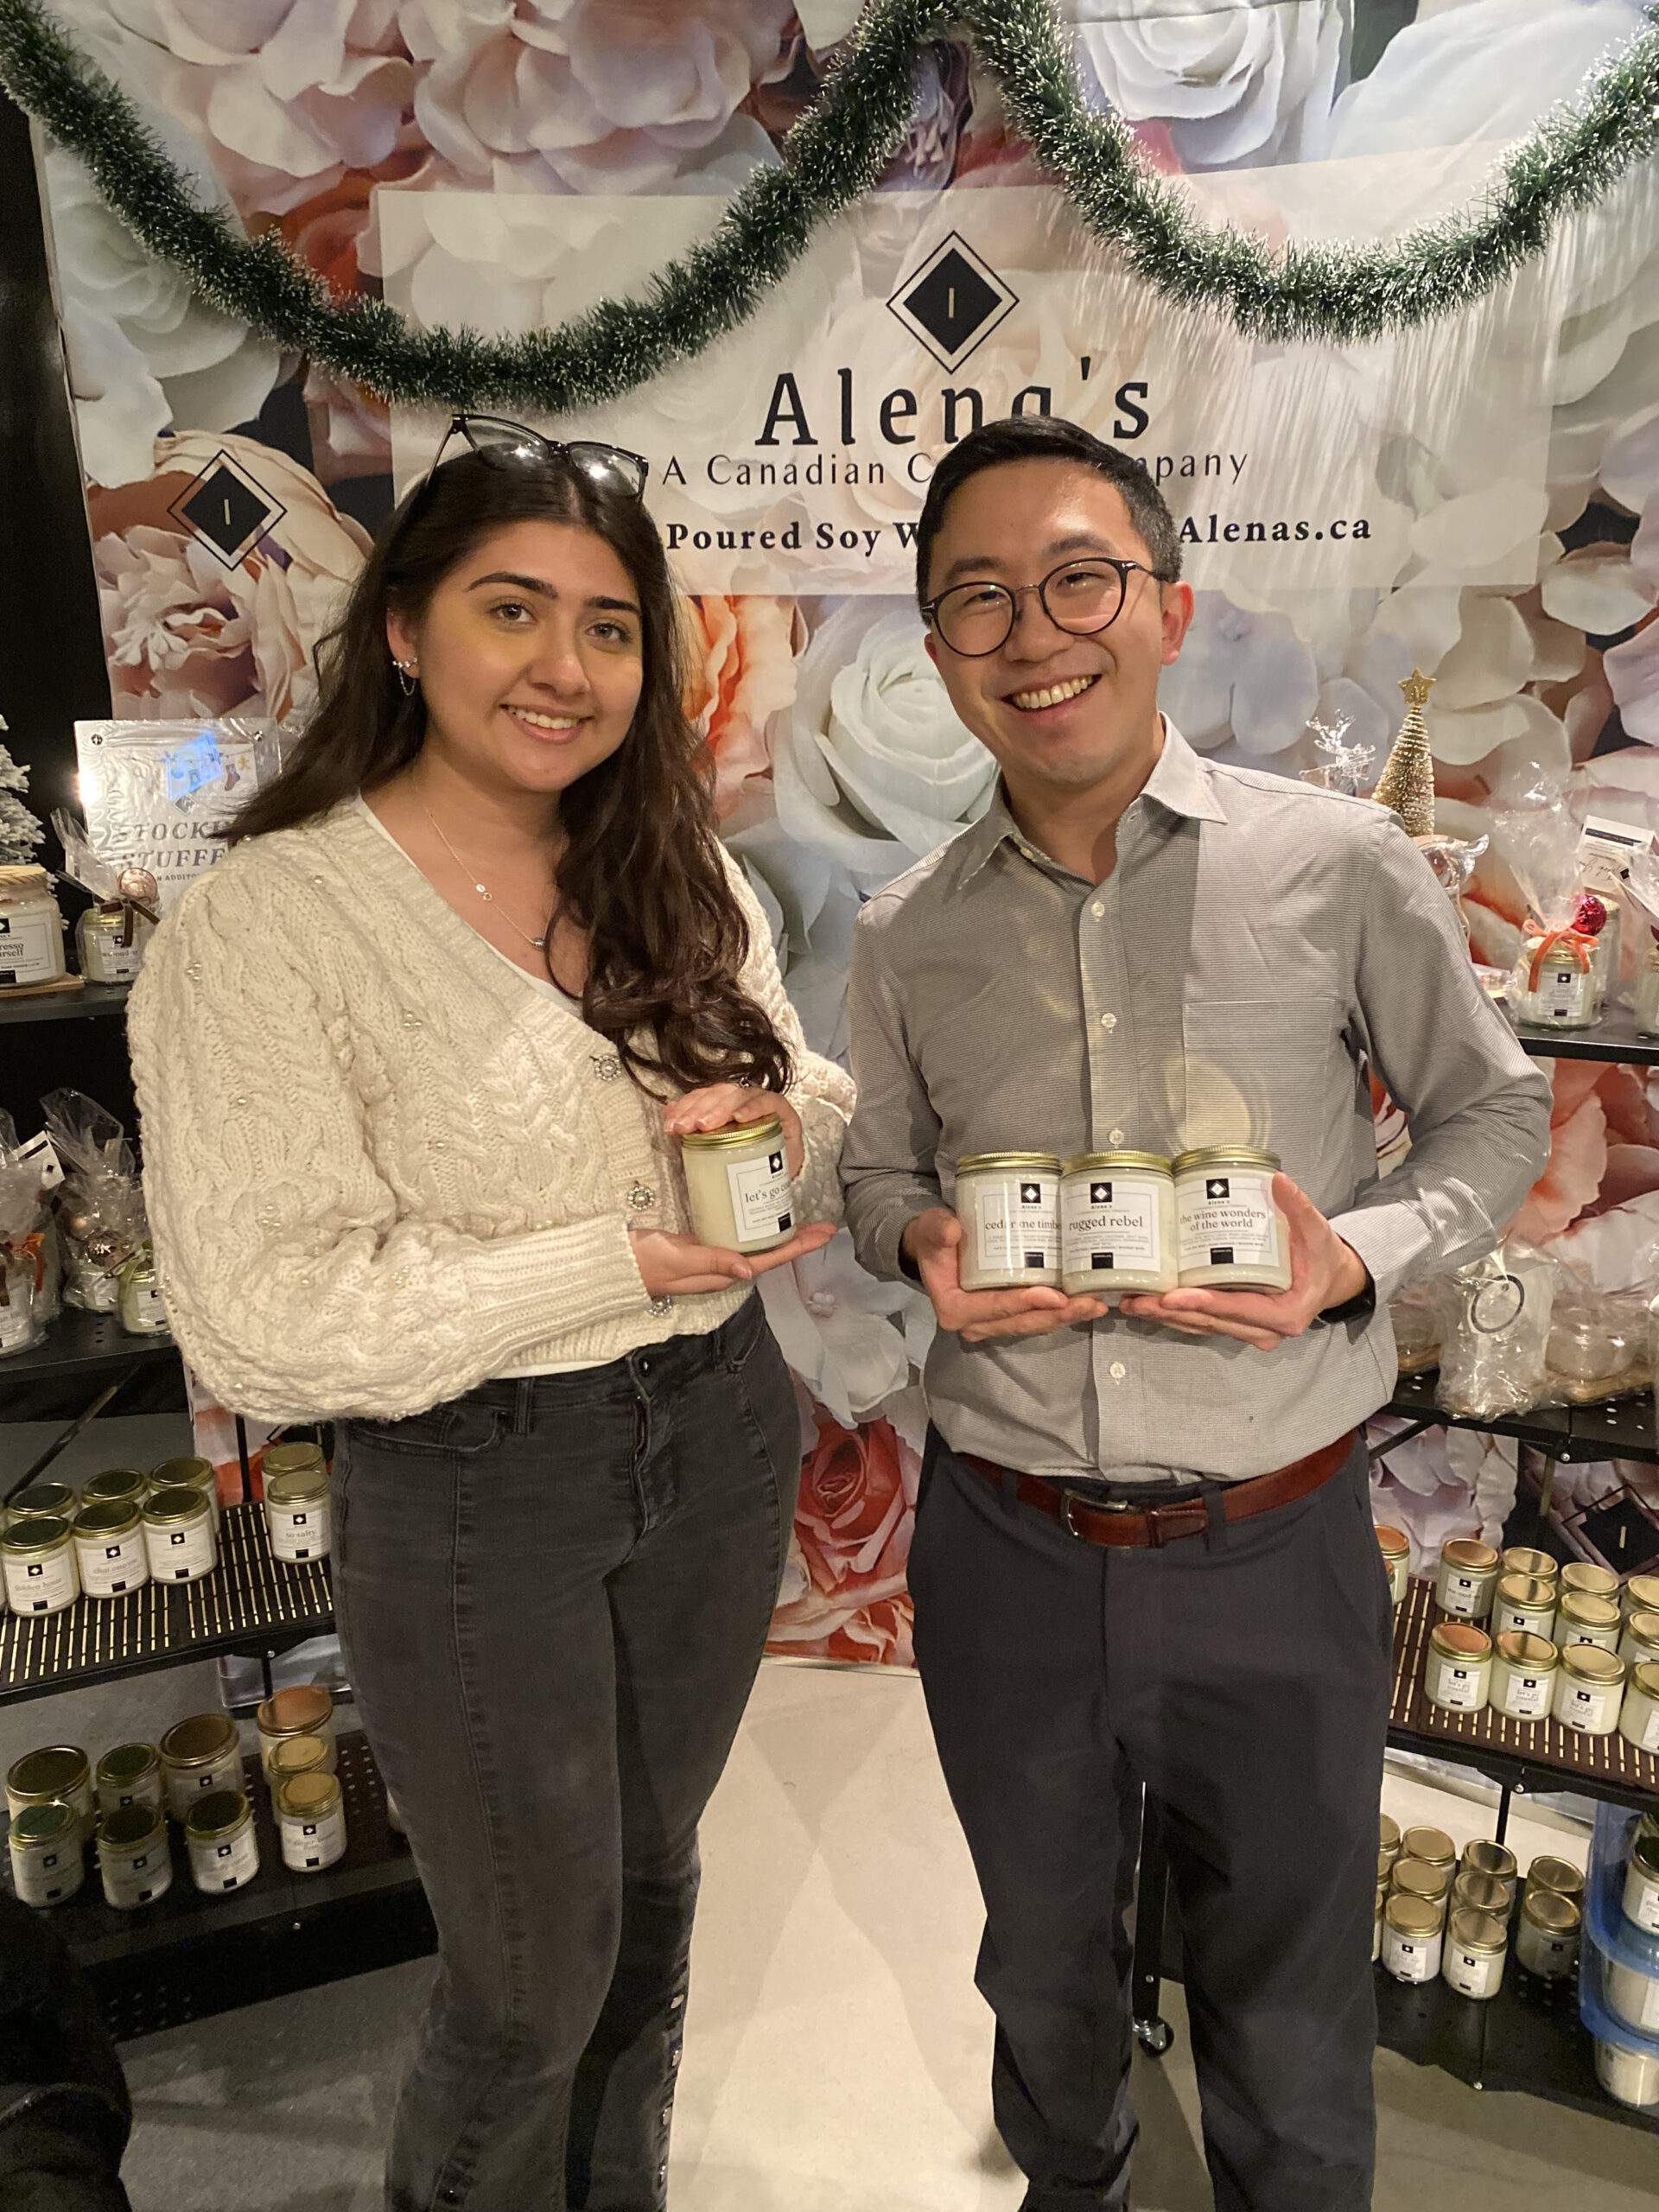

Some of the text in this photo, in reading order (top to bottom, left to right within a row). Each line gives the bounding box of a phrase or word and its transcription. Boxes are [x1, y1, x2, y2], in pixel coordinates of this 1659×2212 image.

[754, 355, 1150, 446] Alena's
[663, 454, 687, 486] A
[707, 454, 885, 486] Canadian
[666, 521, 802, 550] Poured
[816, 522, 881, 557] Soy
[1179, 513, 1372, 543] Alenas.ca
[745, 1189, 768, 1204] let's
[769, 1186, 780, 1199] go
[985, 1219, 1016, 1230] cedr
[1068, 1215, 1143, 1232] rugged rebel
[1179, 1208, 1267, 1224] the wine wonders
[1190, 1217, 1253, 1231] of the world
